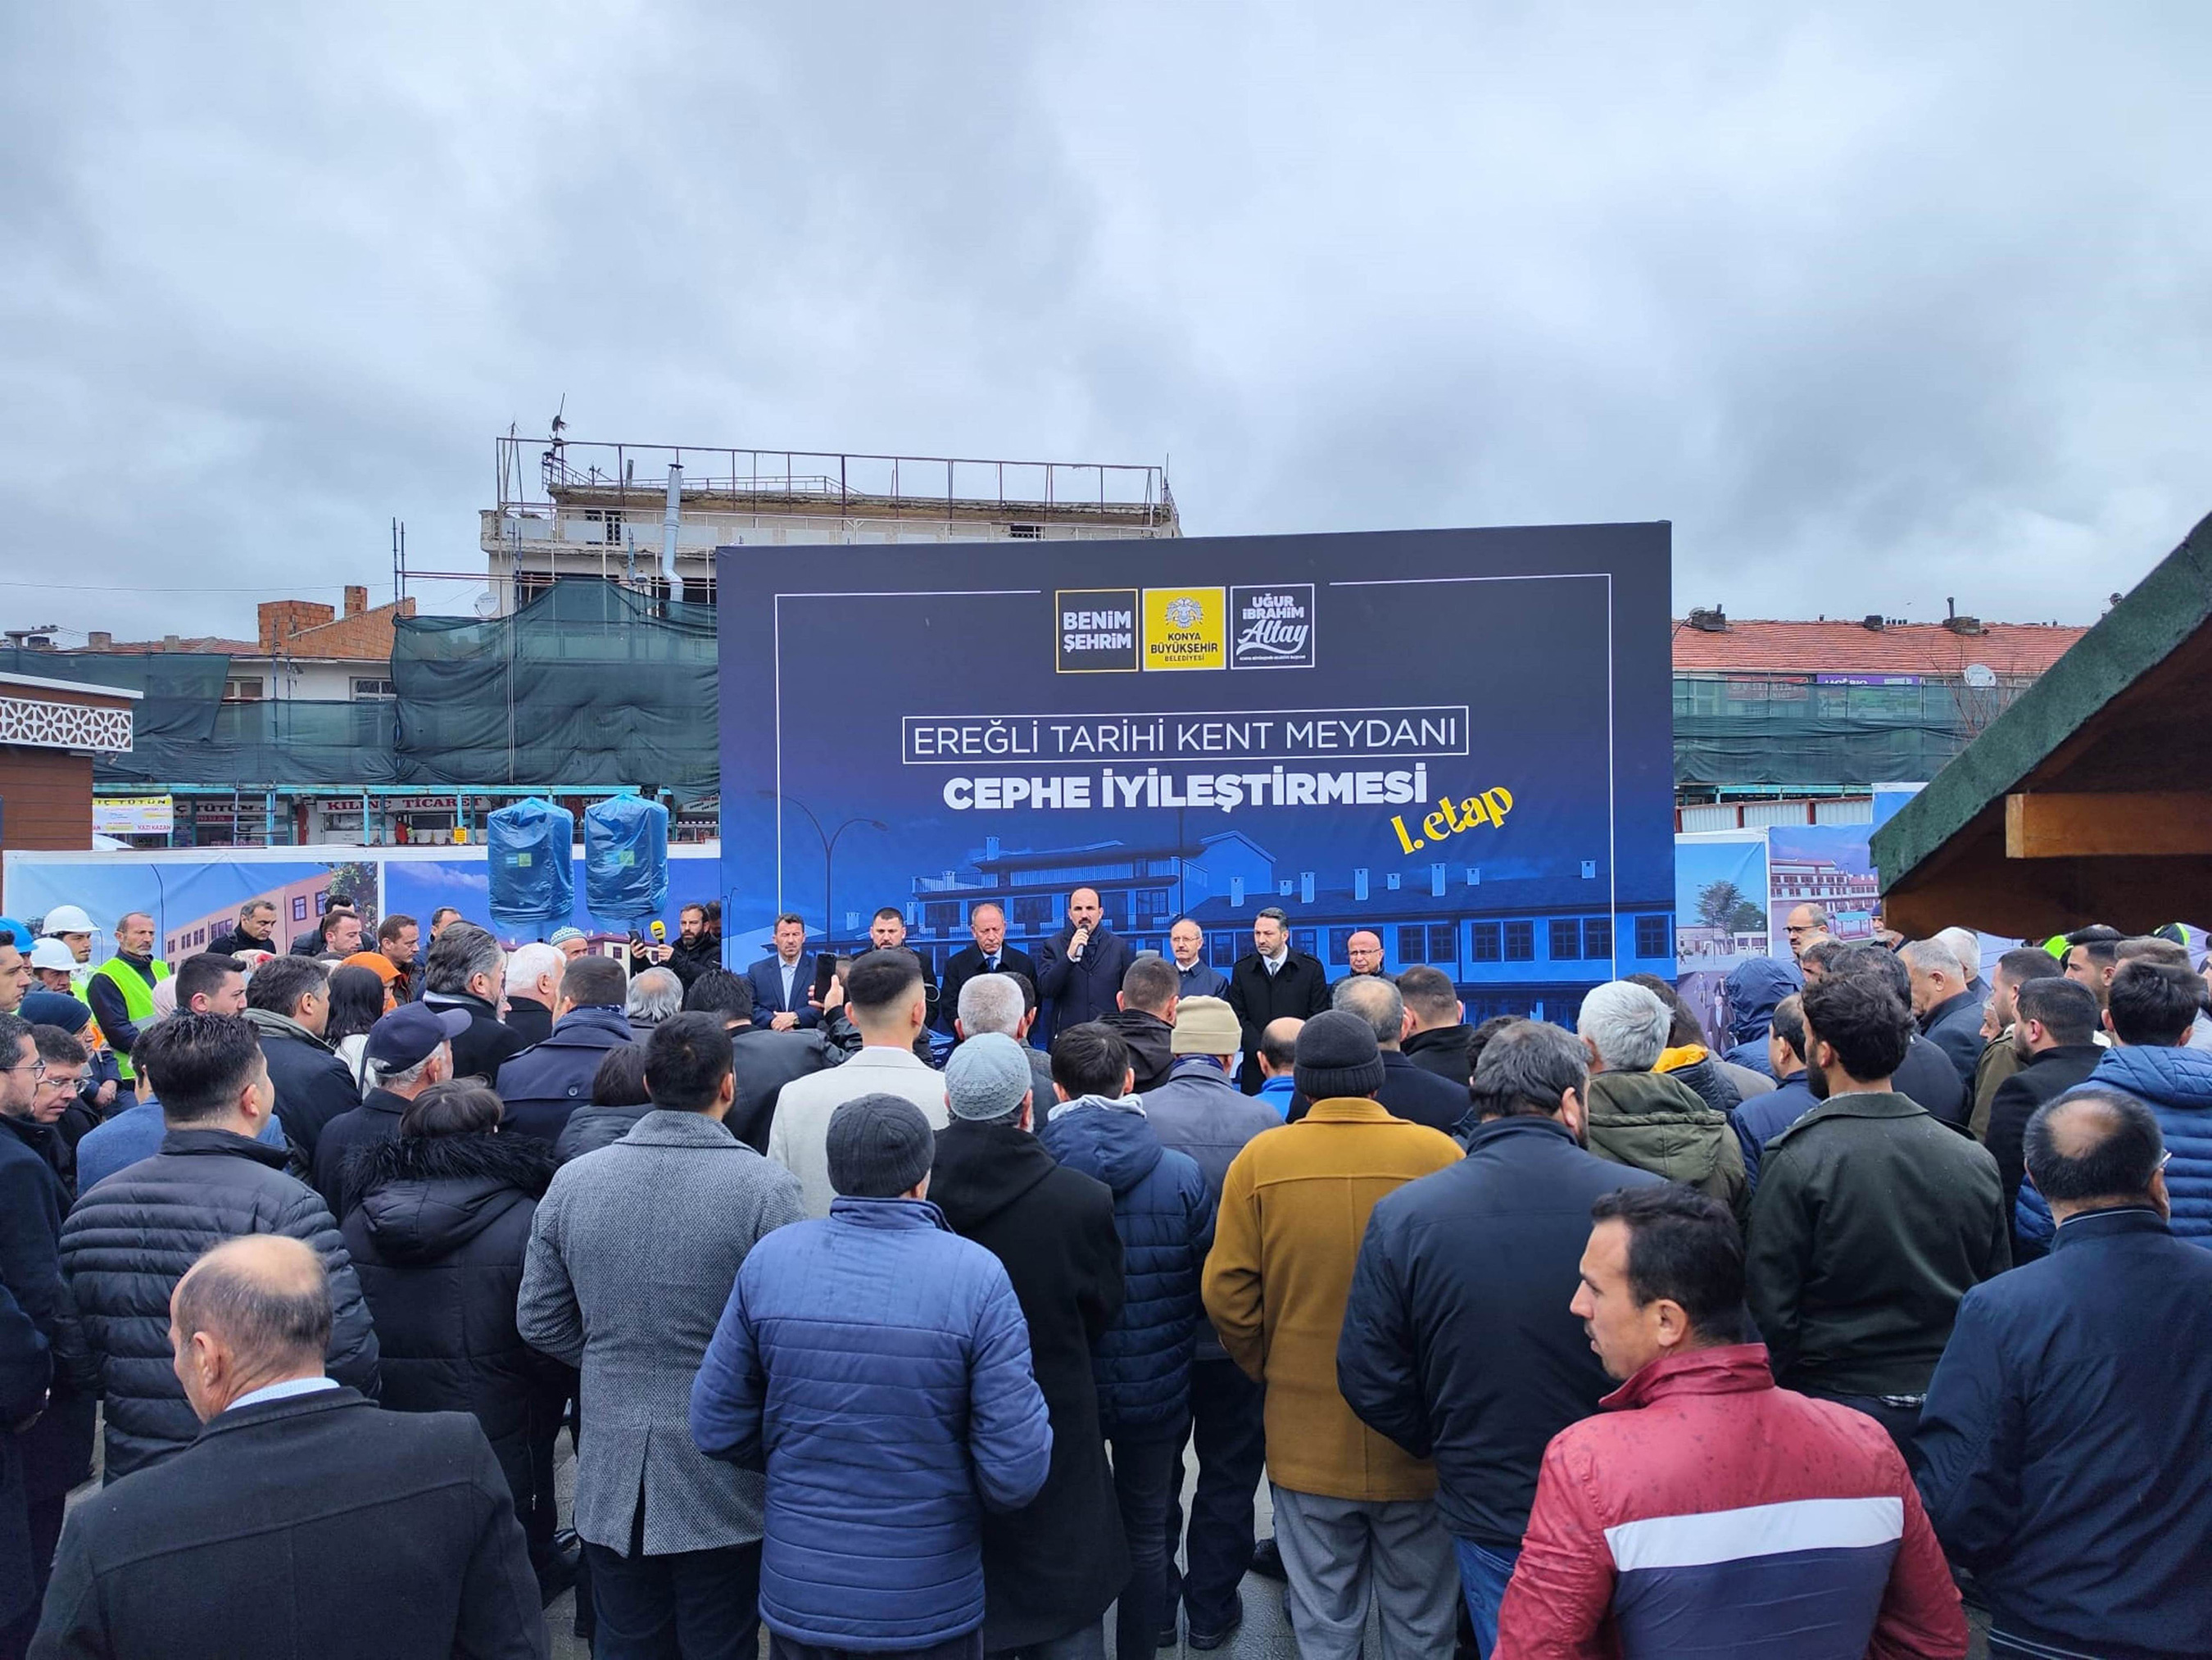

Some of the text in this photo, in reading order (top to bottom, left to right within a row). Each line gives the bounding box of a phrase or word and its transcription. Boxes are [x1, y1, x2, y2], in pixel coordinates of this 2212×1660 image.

[1252, 592, 1294, 608] UĞUR
[1167, 633, 1201, 642] KONYA
[1236, 619, 1309, 655] Altay
[1150, 642, 1218, 655] BÜYÜKŞEHİR
[1164, 653, 1204, 662] BELEDİYESİ
[914, 717, 1456, 755] EREĞLİ TARİHİ KENT MEYDANI
[943, 763, 1427, 813] CEPHE İYİLEŞTİRMESİ
[402, 796, 482, 808] TİCARET
